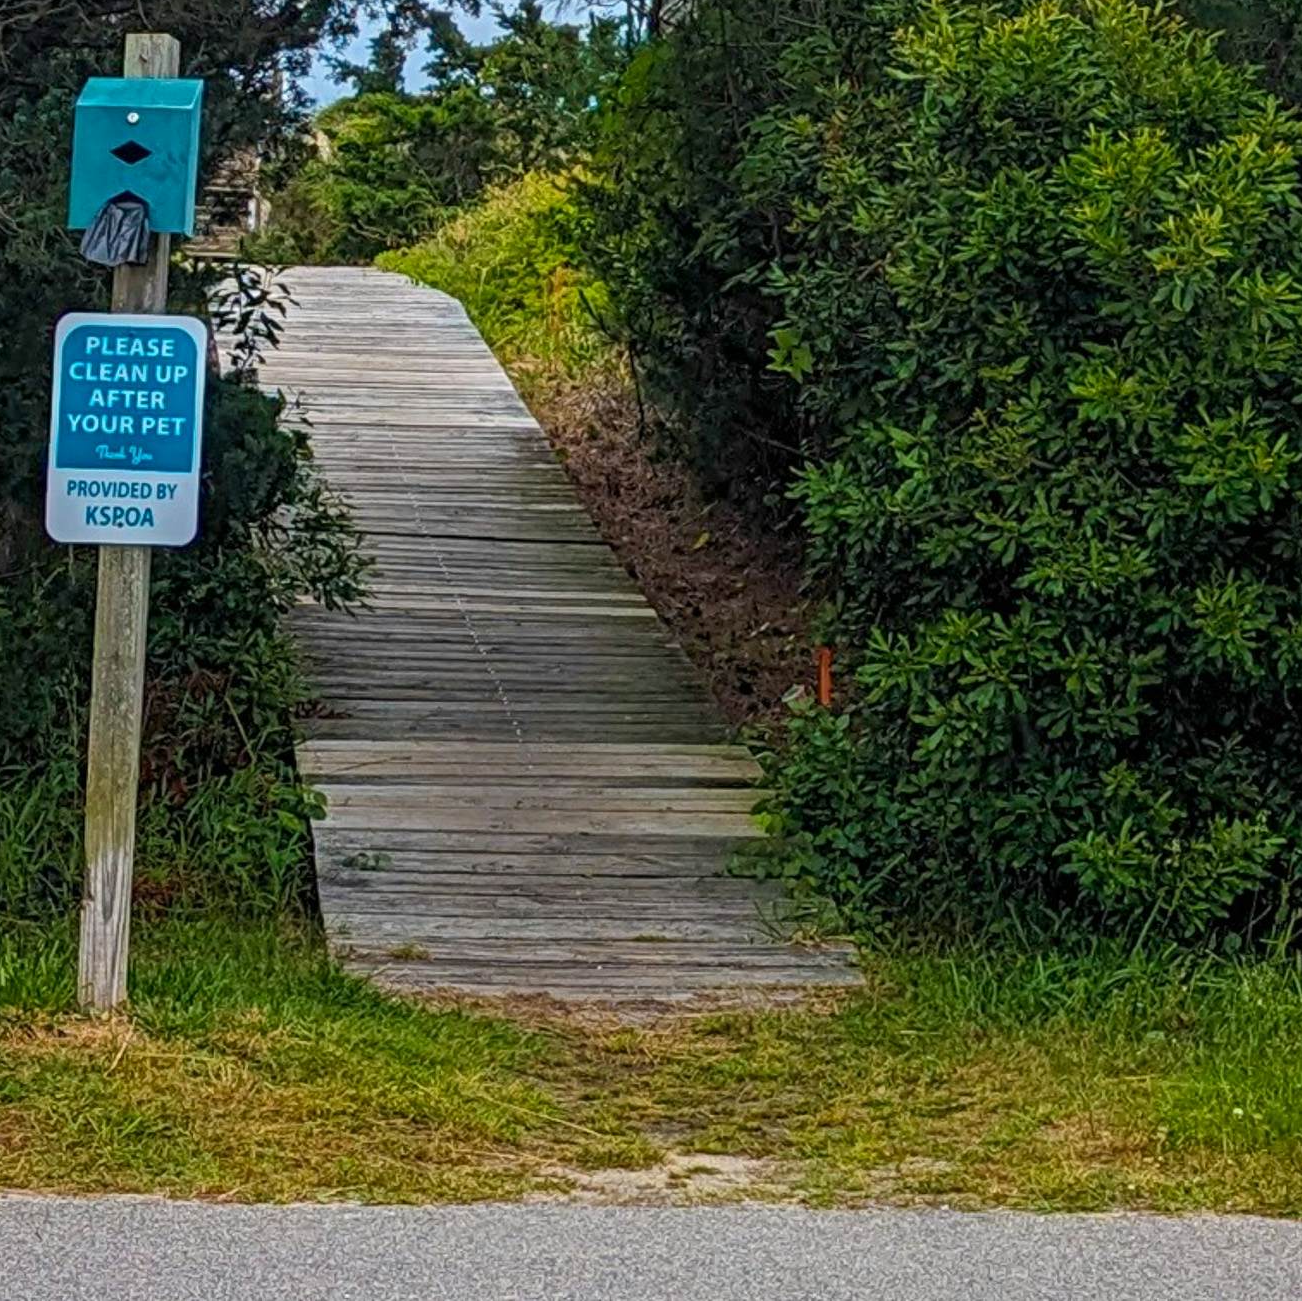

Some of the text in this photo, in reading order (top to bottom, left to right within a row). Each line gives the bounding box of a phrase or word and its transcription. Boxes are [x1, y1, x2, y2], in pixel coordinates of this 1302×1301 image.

[85, 336, 175, 357] PLEASE
[69, 362, 188, 384] CLEAN UP
[88, 389, 166, 410] AFTER
[67, 414, 187, 436] YOUR PET
[95, 444, 154, 465] Thank You
[66, 479, 178, 500] PROVIDED BY
[85, 505, 155, 528] KSPOA
